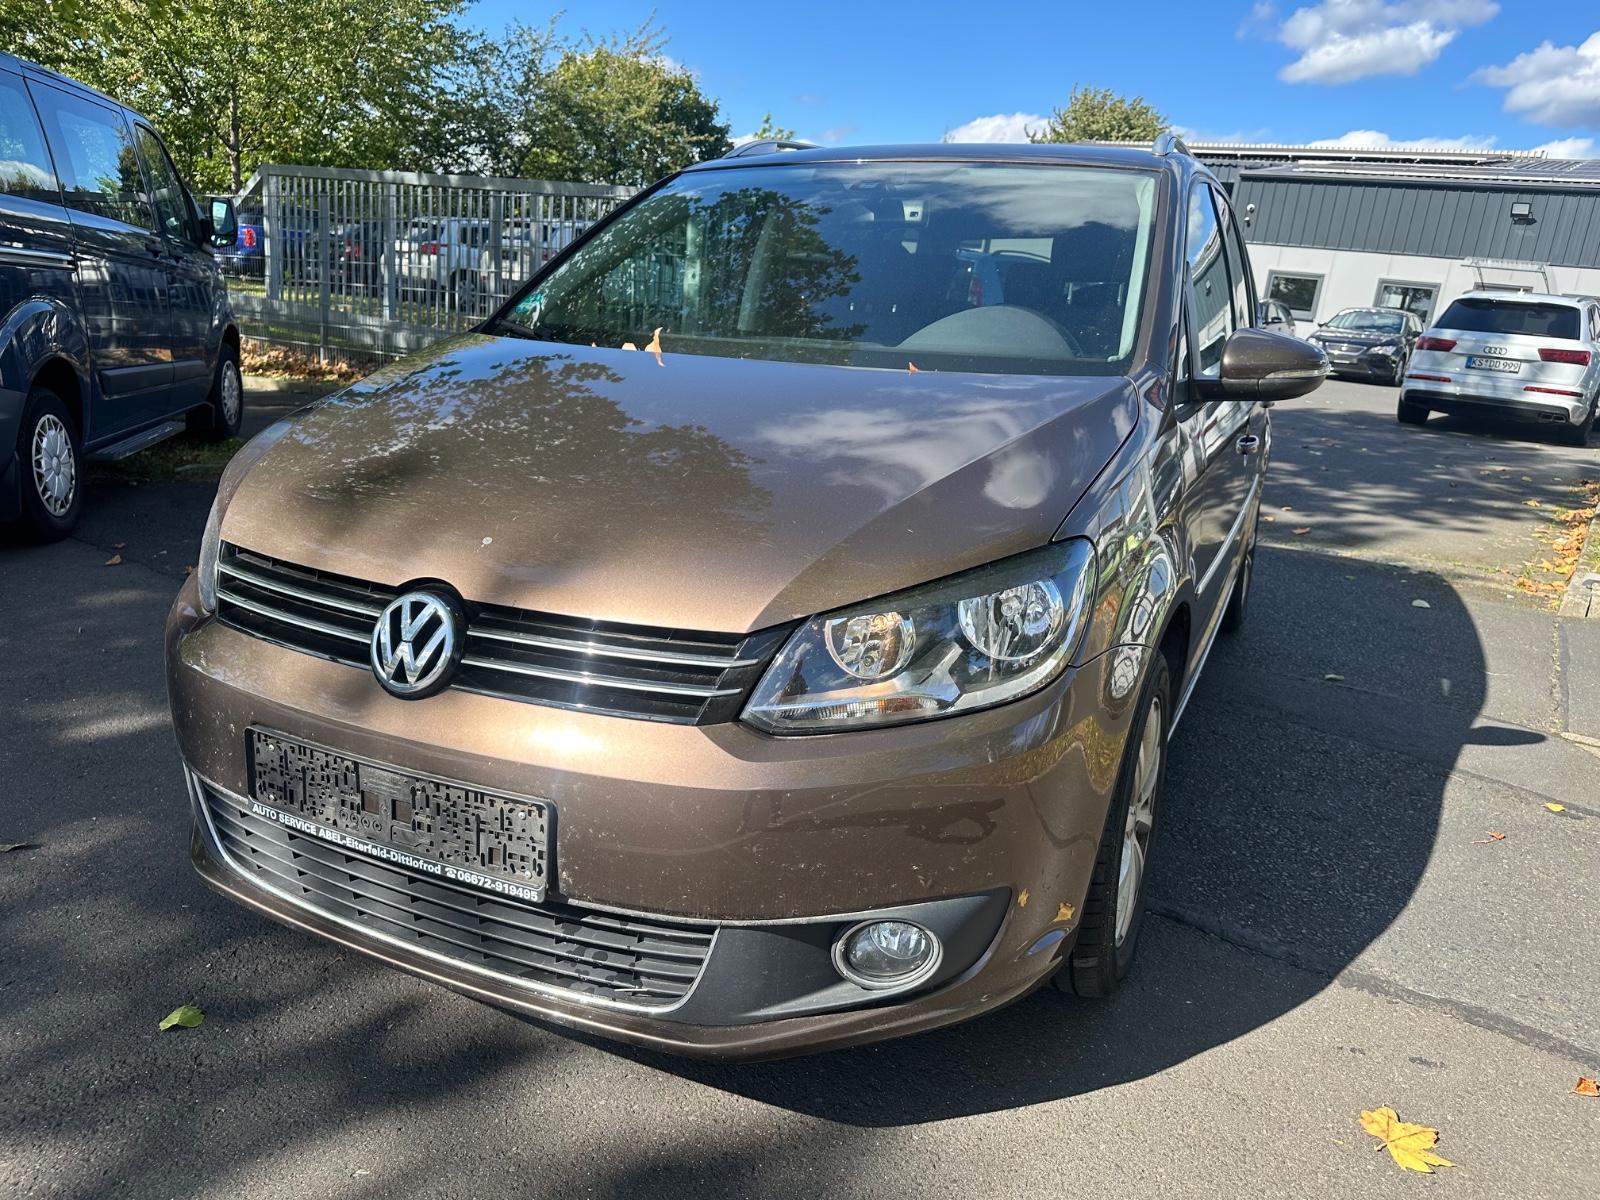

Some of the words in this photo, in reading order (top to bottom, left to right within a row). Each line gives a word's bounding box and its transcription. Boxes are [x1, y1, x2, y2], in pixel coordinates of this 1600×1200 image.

[1471, 359, 1484, 367] KS
[1502, 361, 1519, 371] 999
[375, 595, 450, 689] VW
[252, 803, 277, 820] AUTO
[278, 812, 317, 835] SERVICE
